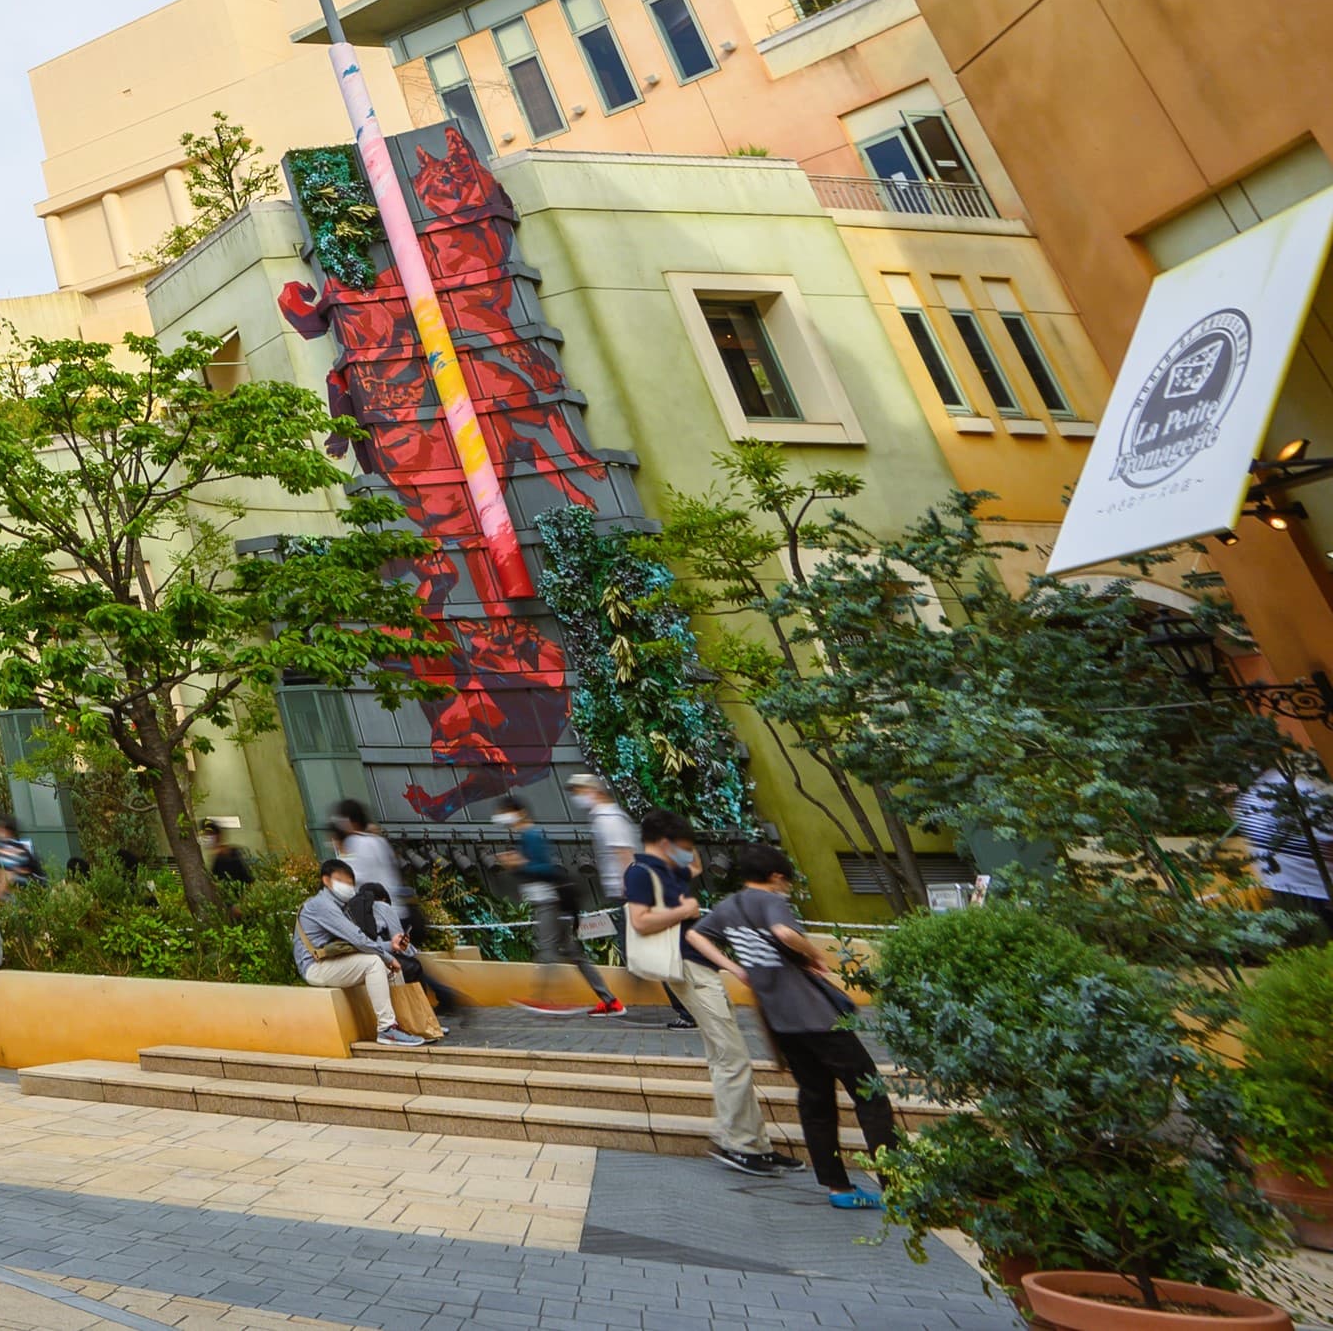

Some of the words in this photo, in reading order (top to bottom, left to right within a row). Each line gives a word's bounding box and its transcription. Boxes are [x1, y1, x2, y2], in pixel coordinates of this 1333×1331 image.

[1134, 420, 1159, 447] La
[1162, 398, 1220, 436] Petite
[1109, 422, 1221, 481] Fromagerie
